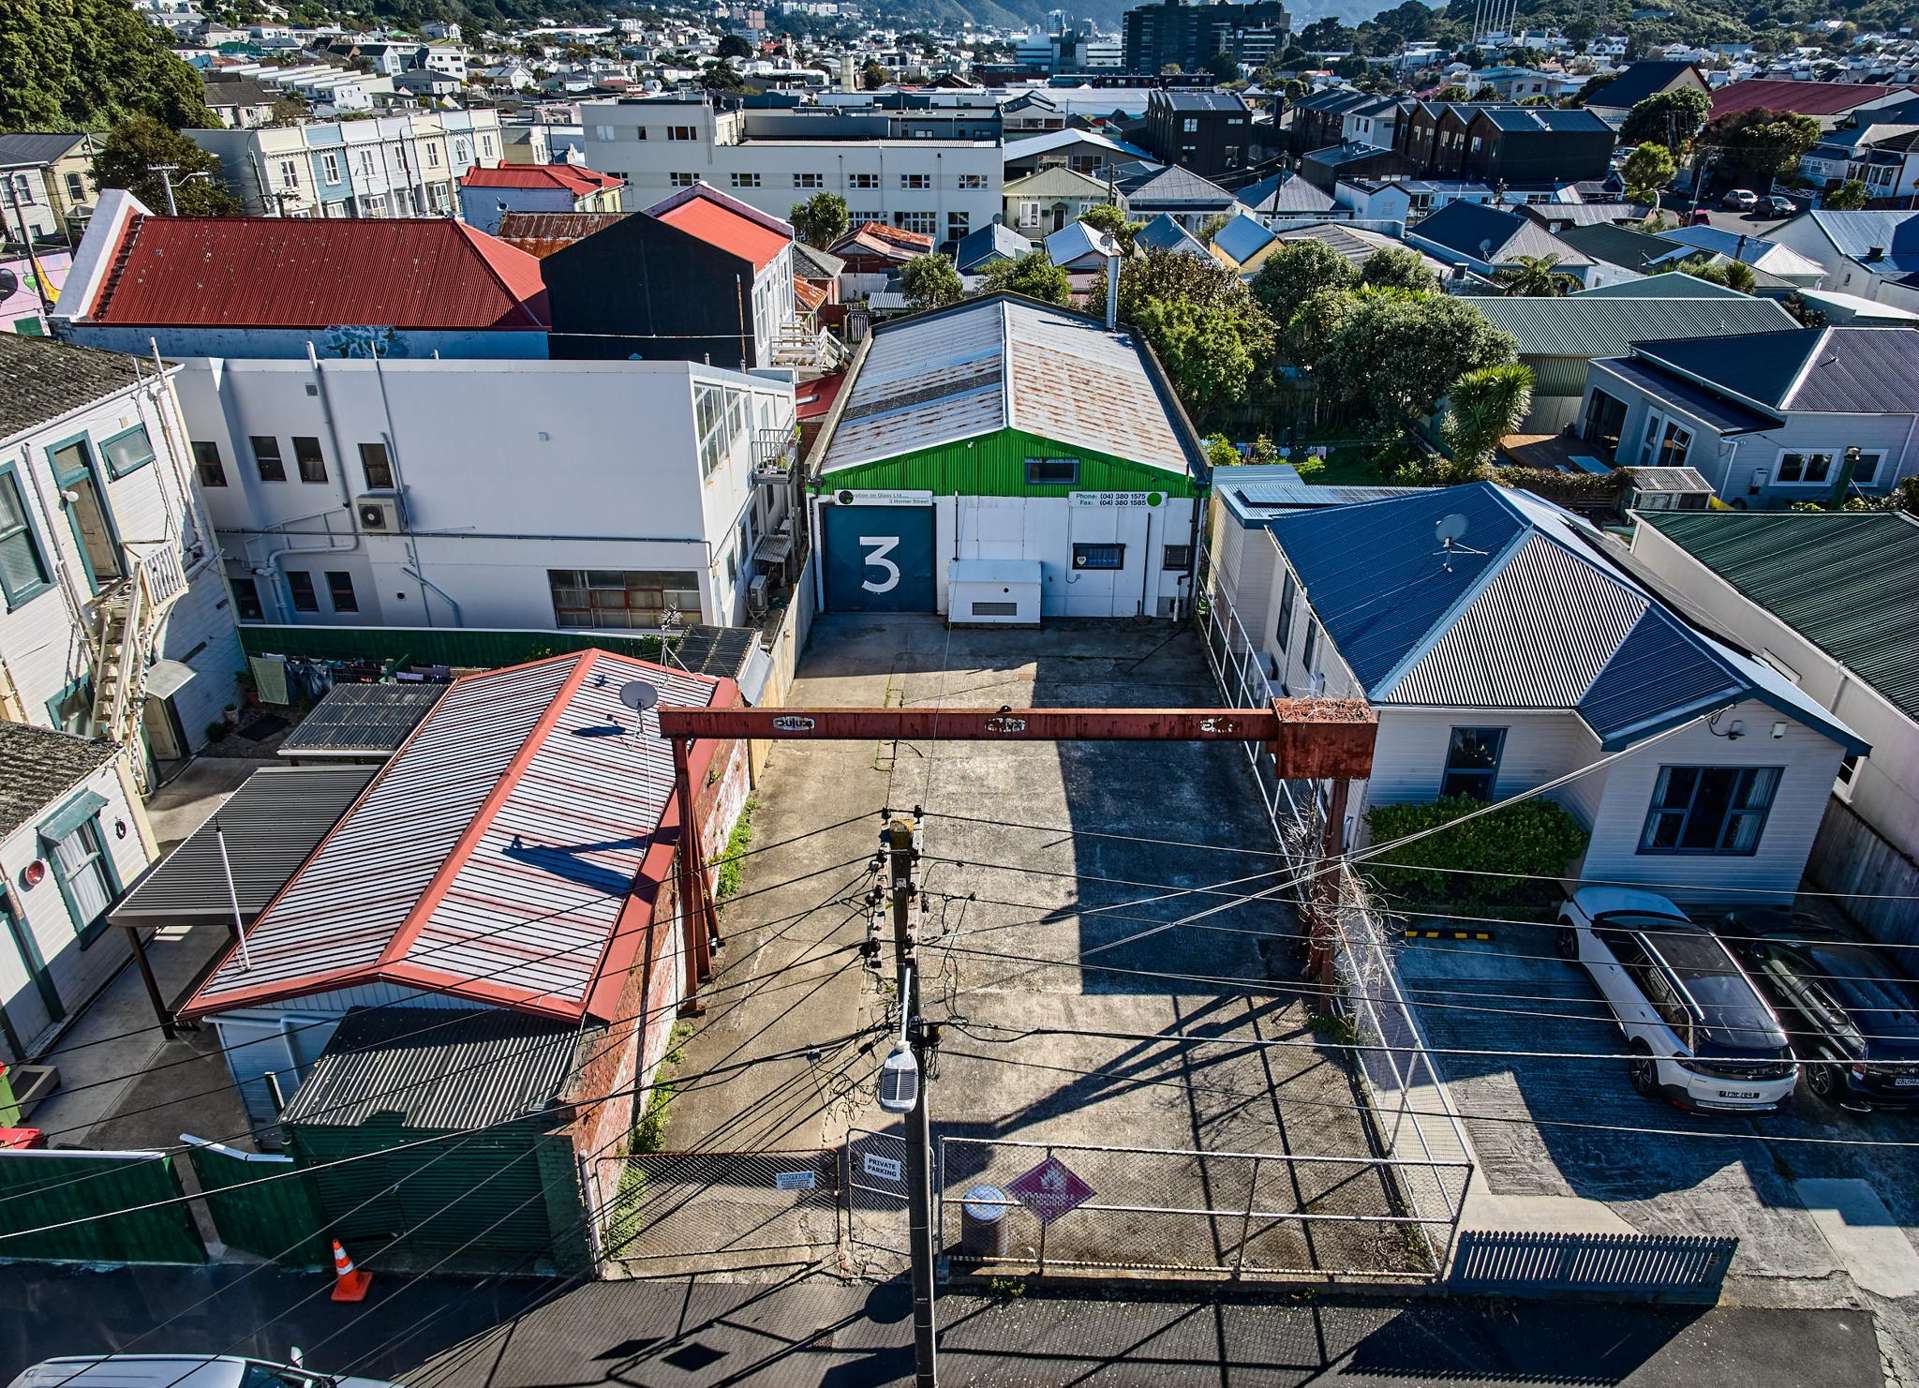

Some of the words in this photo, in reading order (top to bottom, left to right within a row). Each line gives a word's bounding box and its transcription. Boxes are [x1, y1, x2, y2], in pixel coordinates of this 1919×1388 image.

[1100, 492, 1113, 500] (04)
[1100, 499, 1113, 507] (04)
[859, 536, 900, 593] 3
[868, 1157, 896, 1170] PRIVATE
[867, 1164, 897, 1177] PARKING
